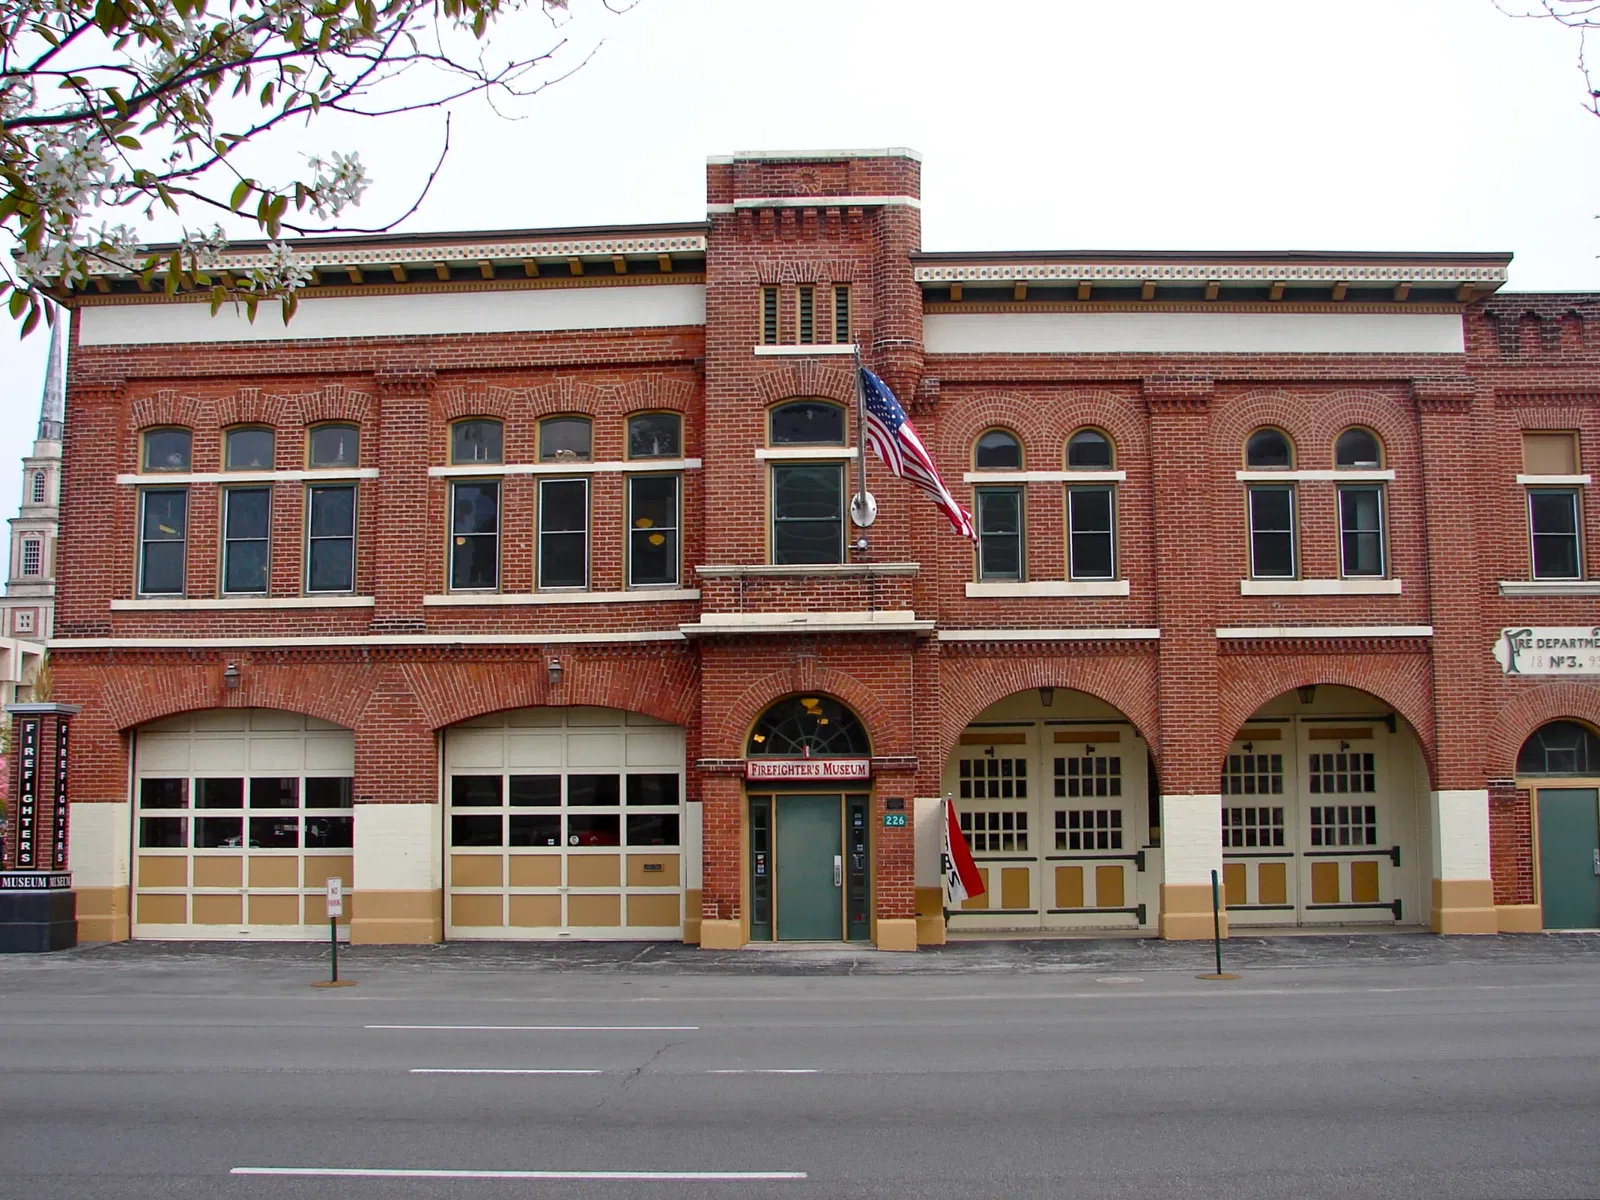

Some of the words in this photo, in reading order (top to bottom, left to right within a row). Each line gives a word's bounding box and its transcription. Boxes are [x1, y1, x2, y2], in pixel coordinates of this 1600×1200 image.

[751, 763, 820, 776] FIREFIGHTER'S
[823, 763, 866, 775] MUSEUM
[21, 724, 35, 862] FIREFIGHTERS
[58, 725, 67, 862] FIREFIGHTERS
[886, 816, 905, 825] 226
[2, 877, 47, 887] MUSEUM
